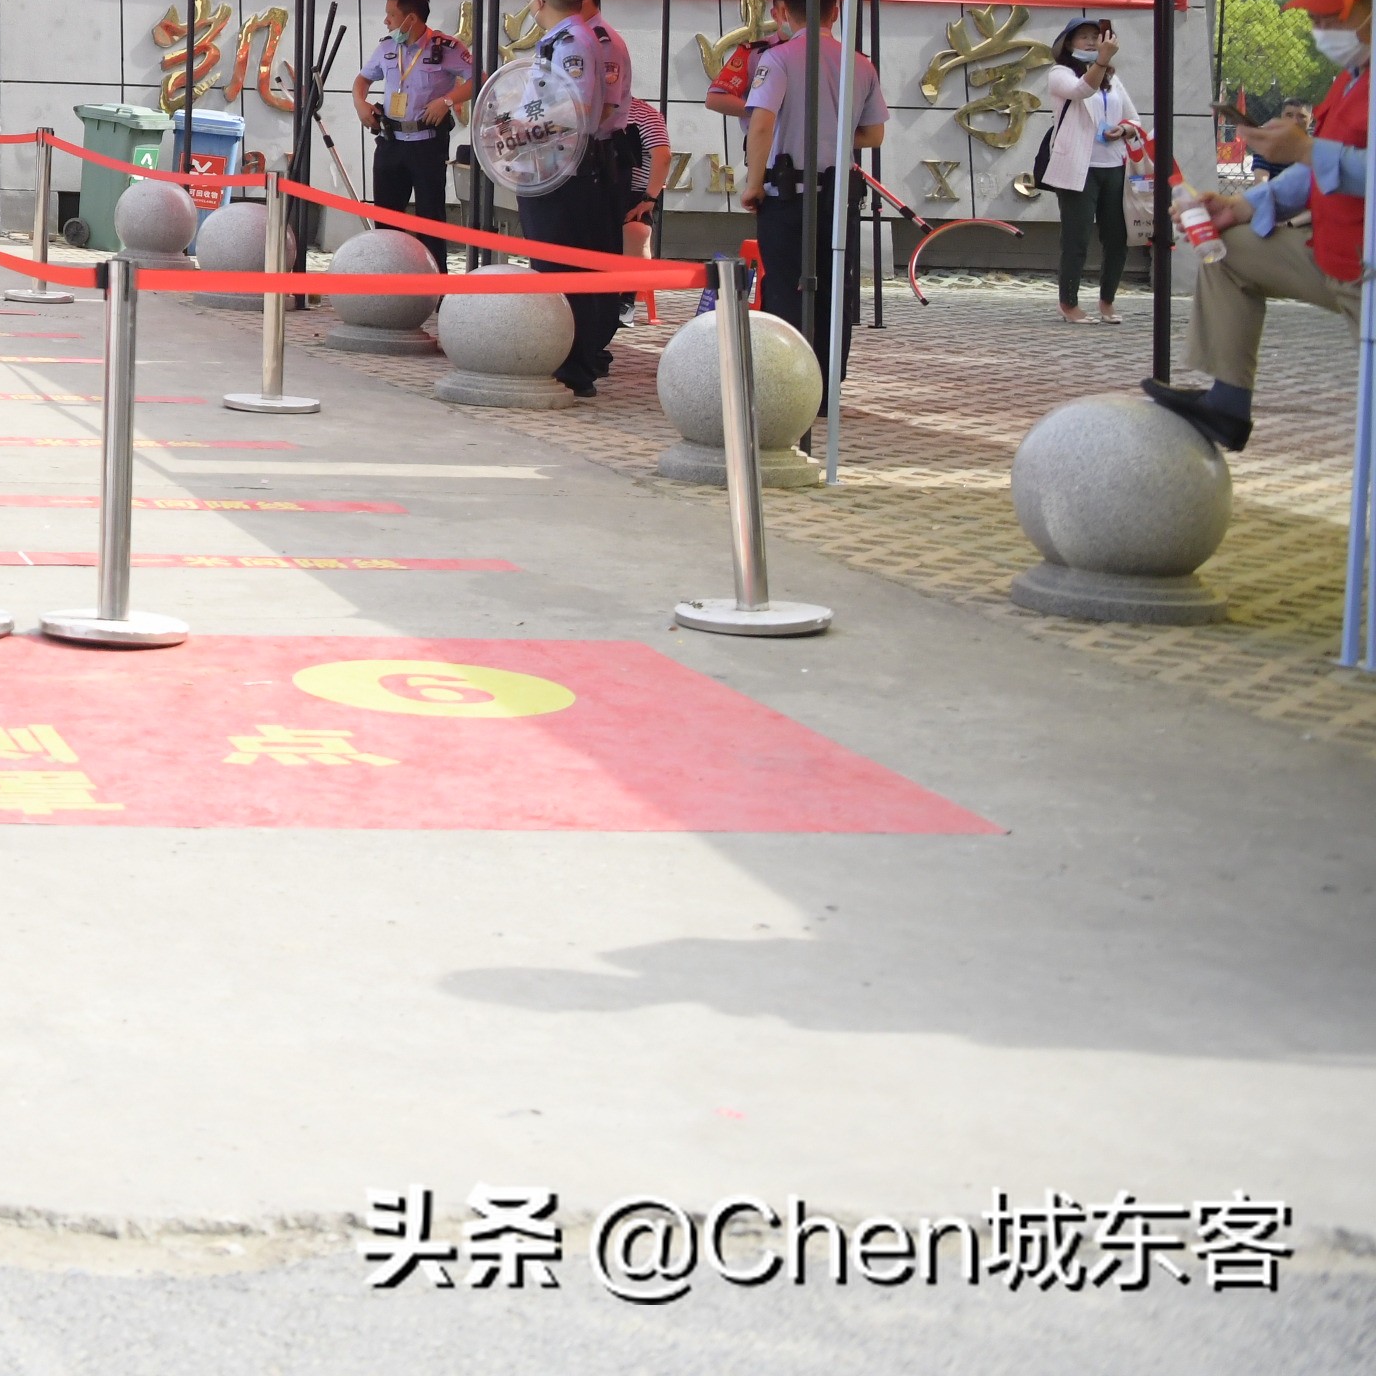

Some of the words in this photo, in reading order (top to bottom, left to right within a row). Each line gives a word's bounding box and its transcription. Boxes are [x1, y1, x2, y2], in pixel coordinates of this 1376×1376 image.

[495, 99, 545, 136] 警察
[496, 120, 557, 155] POLICE
[376, 673, 496, 707] 6
